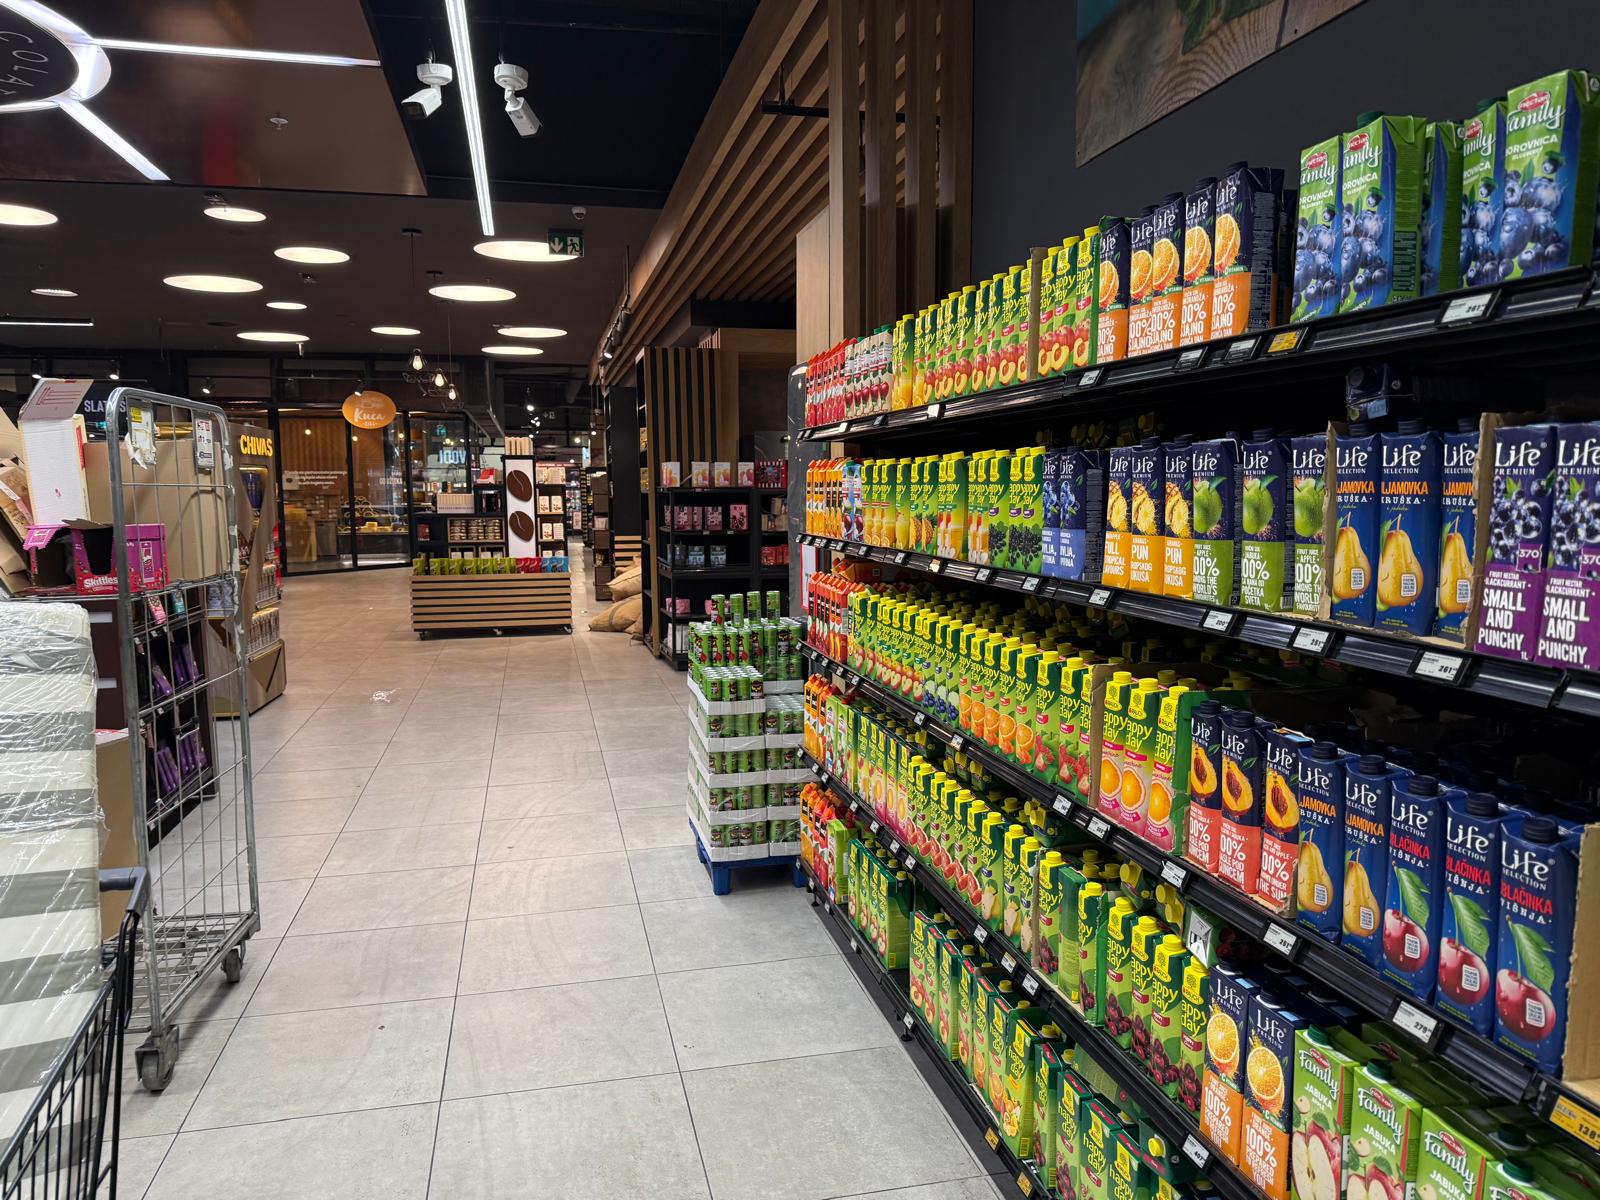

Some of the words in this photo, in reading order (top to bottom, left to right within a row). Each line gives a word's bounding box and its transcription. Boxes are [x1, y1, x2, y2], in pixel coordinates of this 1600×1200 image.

[1507, 105, 1567, 130] amily
[1506, 134, 1558, 156] OROVNICA
[1343, 145, 1382, 170] amily
[1301, 163, 1338, 185] amily
[1343, 172, 1378, 191] OROVNICA
[1056, 275, 1076, 293] appy
[1182, 301, 1206, 324] 00%
[1213, 293, 1235, 314] 00%
[240, 434, 273, 457] CHIVAS
[1336, 446, 1368, 467] Life
[1383, 444, 1421, 467] Life
[1444, 442, 1475, 467] Life
[1494, 440, 1541, 468] Life
[1557, 438, 1600, 467] Life
[1132, 456, 1153, 473] Life
[1166, 455, 1187, 473] Life
[1193, 452, 1218, 470] Life
[1244, 450, 1269, 469] Life
[1293, 448, 1324, 468] Life
[1495, 467, 1535, 476] PREMIUM
[989, 483, 1004, 496] appy
[1023, 483, 1040, 496] appy
[1337, 494, 1367, 502] RUŠKA
[1381, 481, 1428, 494] LJAMOVKA
[1132, 543, 1149, 561] PUN
[1166, 546, 1182, 565] PUN
[1519, 549, 1540, 559] 370
[1194, 557, 1220, 576] 00%
[1243, 559, 1269, 579] 00%
[84, 577, 119, 589] Skittles
[1246, 595, 1260, 605] SVETA
[1483, 588, 1526, 611] SMALL
[1543, 596, 1590, 622] SMALL
[1486, 608, 1513, 630] AND
[1546, 618, 1576, 642] AND
[1478, 627, 1524, 651] PUNCHY
[1538, 639, 1588, 664] PUNCHY
[984, 666, 1000, 679] appy
[1000, 672, 1015, 687] appy
[1016, 680, 1031, 695] appy
[1036, 686, 1055, 703] appy
[1060, 694, 1080, 712] appy
[1104, 711, 1129, 731] appy
[1127, 722, 1152, 741] appy
[1191, 717, 1210, 743] Life
[1155, 731, 1174, 749] app
[1222, 730, 1245, 757] Life
[1267, 743, 1292, 770] Life
[1298, 762, 1329, 790] Life
[1346, 777, 1377, 809] Life
[1300, 809, 1330, 825] RUŠKA
[1346, 800, 1375, 817] SELECTION
[1391, 796, 1428, 831] Life
[1190, 817, 1210, 843] 00%
[1345, 812, 1384, 837] LJAMOVKA
[1392, 819, 1426, 838] SELECTION
[1447, 817, 1489, 854] Life
[1221, 835, 1246, 860] 00%
[1390, 831, 1431, 860] BLAČINKA
[1447, 841, 1486, 863] SELECTION
[1233, 859, 1244, 873] POD
[1262, 852, 1289, 881] 00%
[1446, 855, 1491, 887] BLAČINKA
[1502, 841, 1549, 882] Life
[1502, 867, 1547, 891] SELECTION
[1500, 880, 1552, 915] BLAČINKA
[1107, 937, 1130, 958] appy
[1131, 956, 1153, 980] appy
[1152, 977, 1178, 1003] appy
[1216, 978, 1243, 1011] Life
[1181, 999, 1207, 1026] appy
[1256, 1009, 1286, 1043] Life
[1257, 1027, 1282, 1050] PREMIUM
[1299, 1050, 1339, 1100] Family
[1205, 1086, 1232, 1127] 100%
[1304, 1082, 1333, 1111] JABUKA
[1357, 1087, 1403, 1145] Family
[1363, 1123, 1396, 1156] JABUKA
[1578, 1122, 1597, 1140] 138
[1083, 1134, 1107, 1168] happy
[1246, 1124, 1277, 1169] 100%
[1424, 1131, 1476, 1195] Family
[1109, 1163, 1135, 1200] happy
[1430, 1169, 1466, 1200] JABUKA
